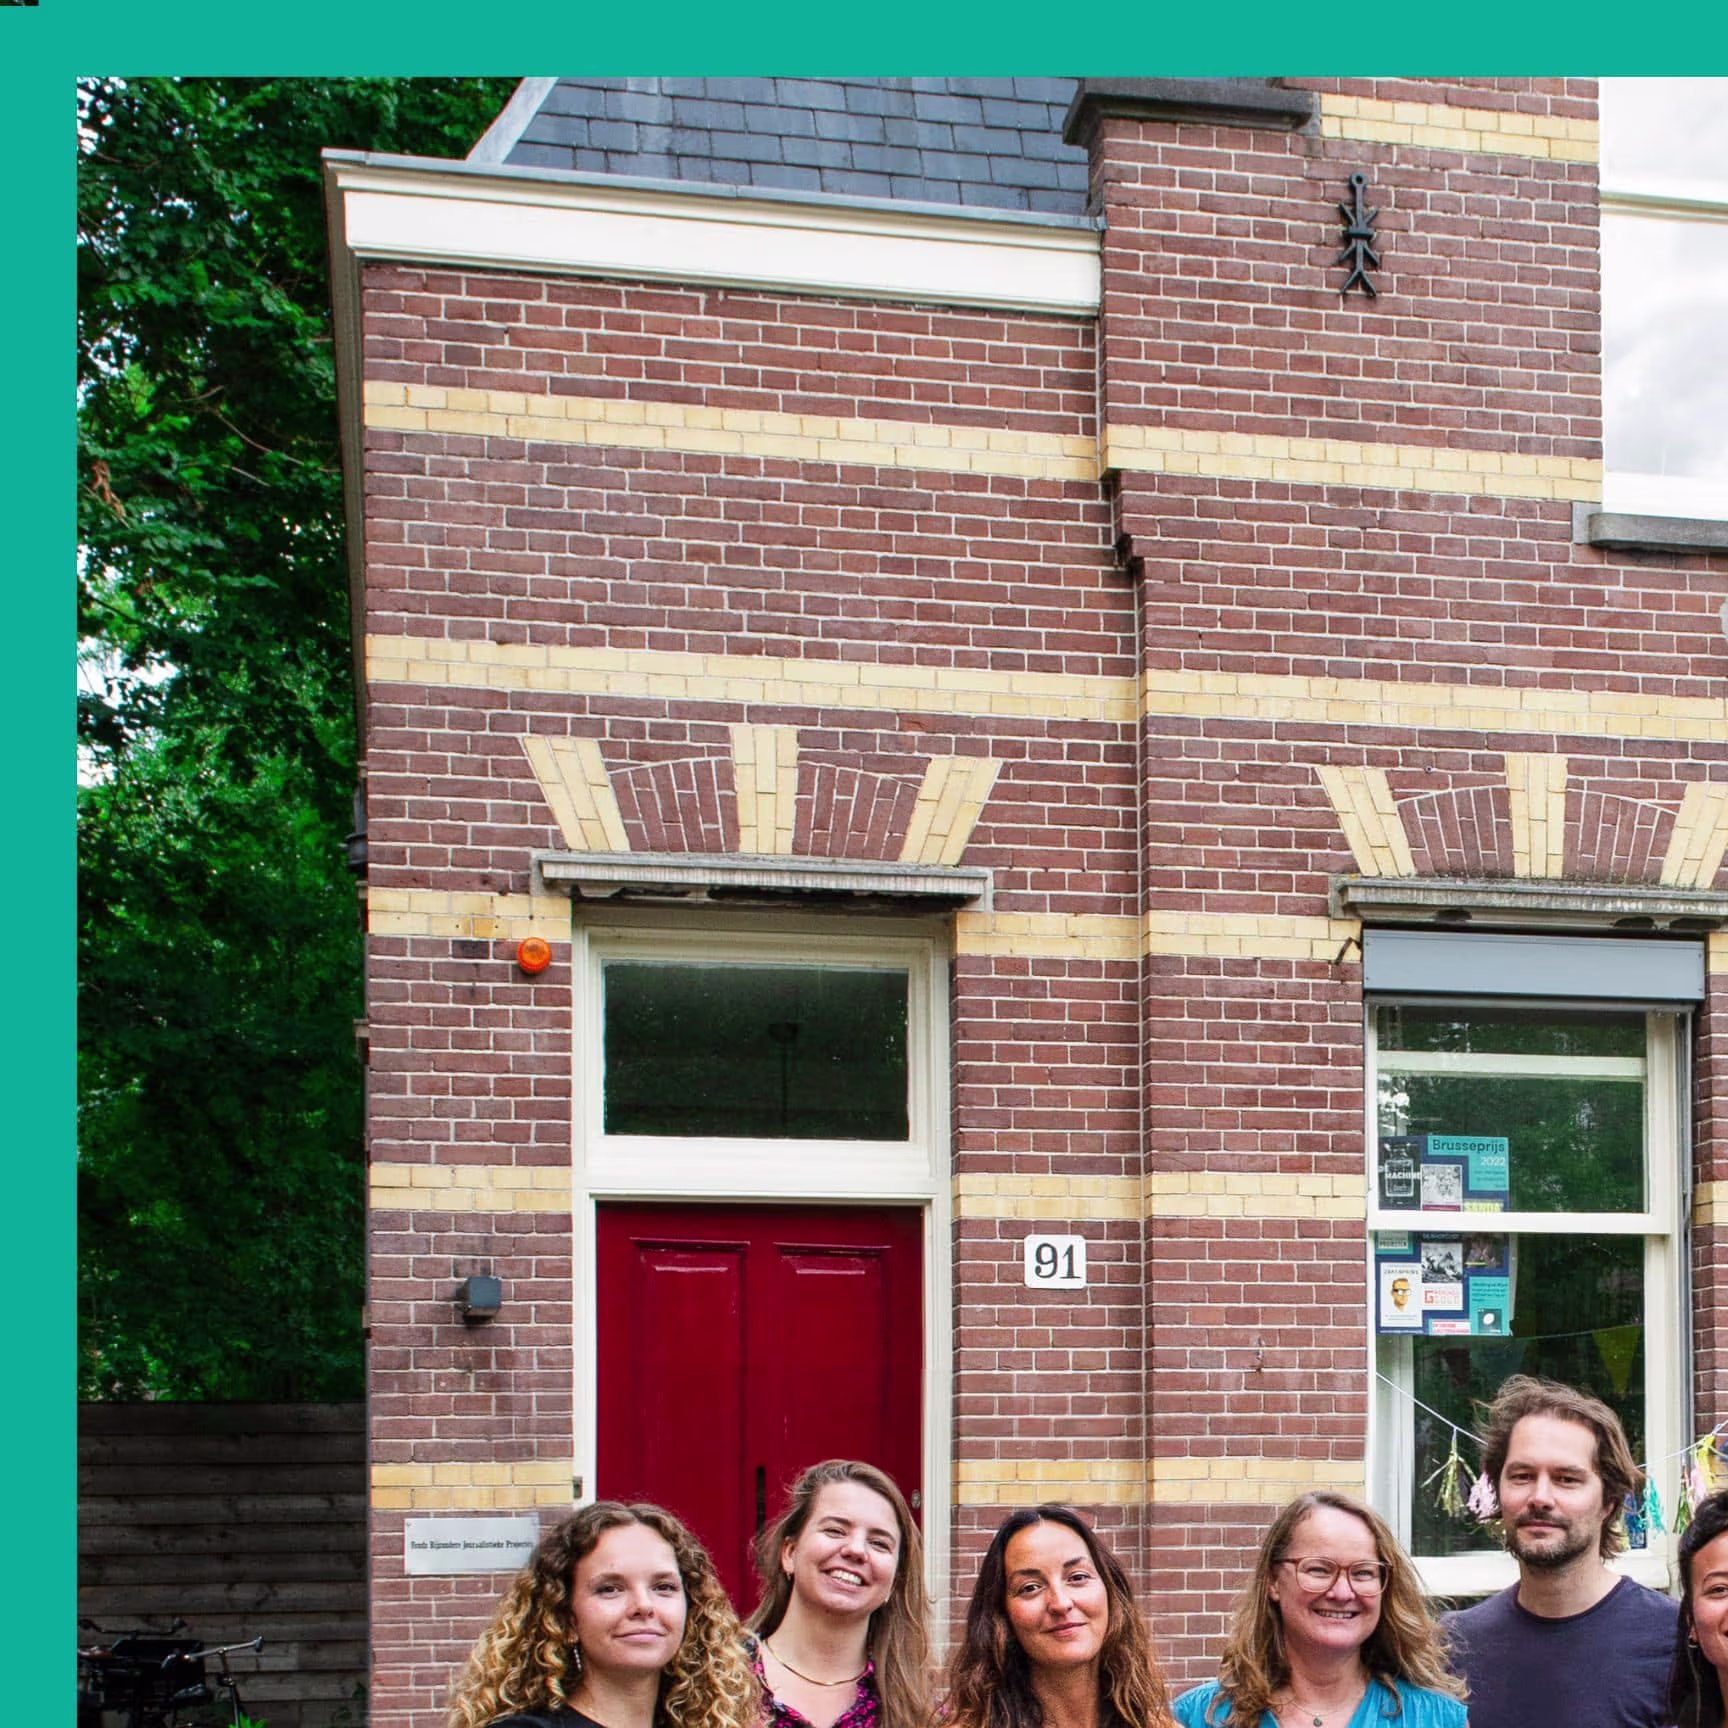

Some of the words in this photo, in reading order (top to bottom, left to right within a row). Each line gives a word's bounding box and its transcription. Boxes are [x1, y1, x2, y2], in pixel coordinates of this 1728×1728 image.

[1432, 1139, 1505, 1154] Brusseprijs
[1480, 1157, 1506, 1167] 2022
[1035, 1243, 1082, 1279] 91
